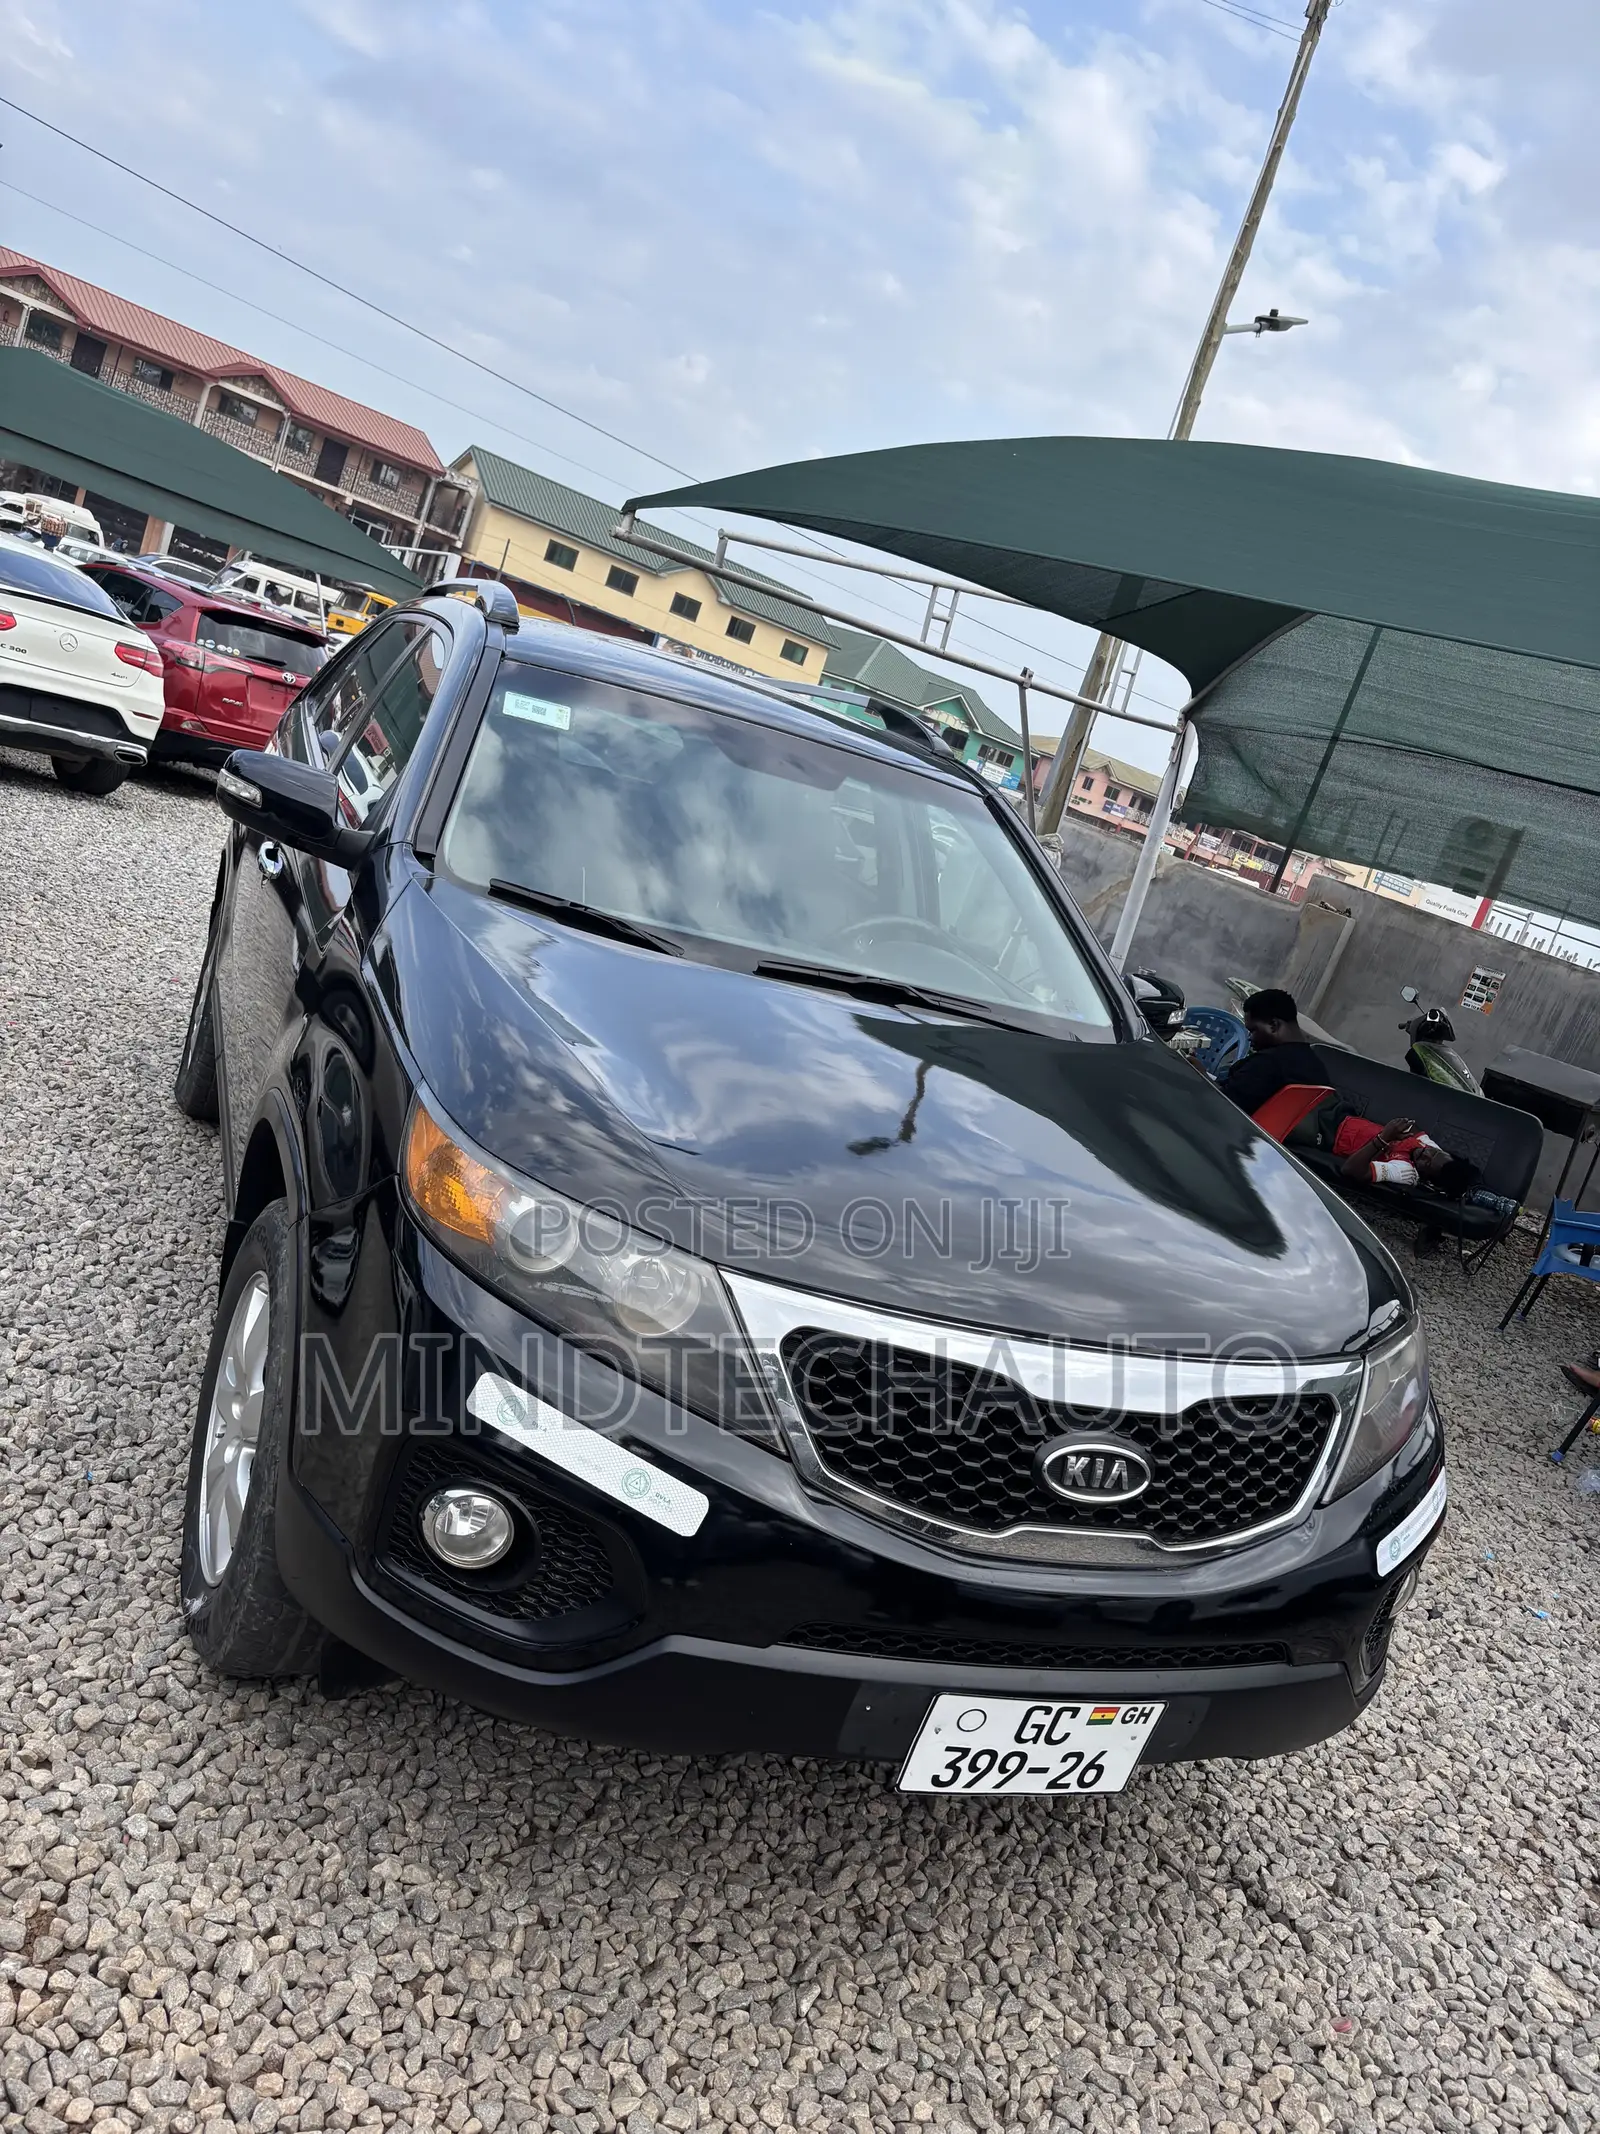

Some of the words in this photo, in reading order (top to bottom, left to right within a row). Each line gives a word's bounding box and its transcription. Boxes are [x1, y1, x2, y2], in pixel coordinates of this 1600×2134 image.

[9, 645, 27, 654] 300
[1425, 898, 1443, 910] Quality
[1442, 904, 1457, 914] Fuels
[1457, 910, 1469, 919] Only
[1063, 1455, 1129, 1490] KIA
[1013, 1705, 1082, 1746] GC
[1120, 1706, 1155, 1725] GH
[930, 1746, 1109, 1790] 399-26
